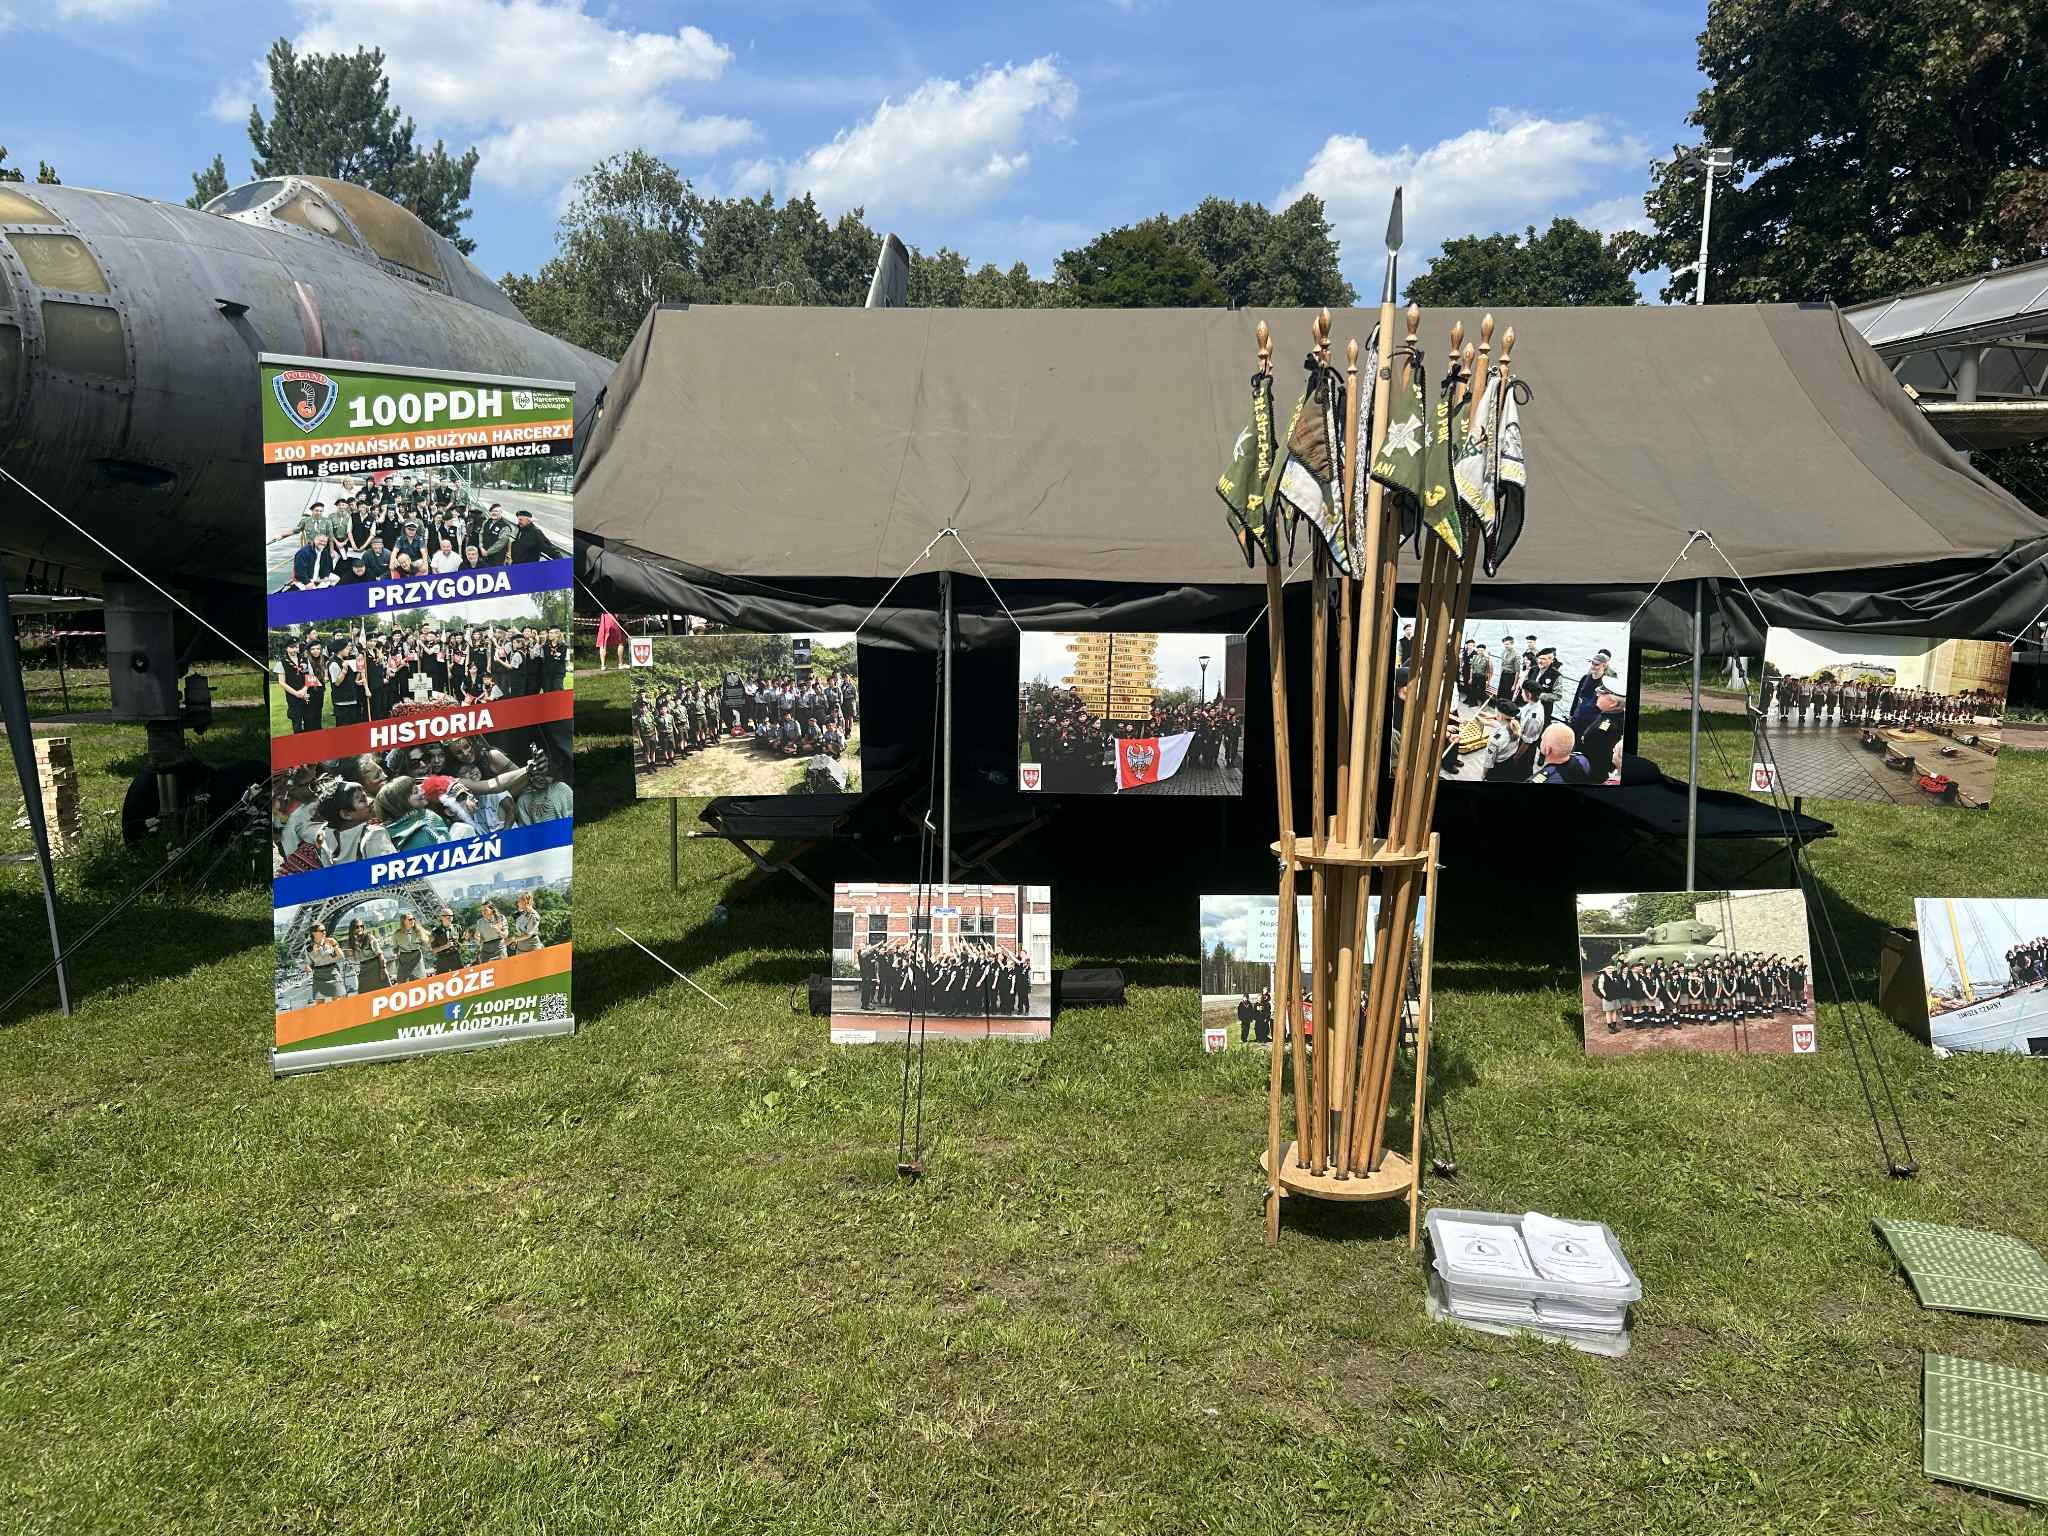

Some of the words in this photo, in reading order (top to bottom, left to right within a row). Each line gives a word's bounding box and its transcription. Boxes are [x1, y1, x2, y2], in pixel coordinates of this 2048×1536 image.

[284, 371, 327, 384] POLAND
[349, 389, 502, 428] 100PDH
[274, 445, 306, 461] 100
[310, 437, 410, 458] POZNAŃSKA
[415, 431, 488, 449] DRUŻYNA
[492, 424, 572, 442] HARCERZY
[286, 463, 314, 477] im.
[318, 456, 394, 476] generała
[397, 448, 488, 467] Stanisława
[491, 442, 551, 458] Maczka
[368, 571, 512, 609] PRZYGODA
[370, 709, 494, 748] HISTORIA
[371, 837, 501, 885] PRZYJAŹŃ
[372, 968, 496, 1016] PODRÓŻE
[397, 1011, 538, 1039] WWW.100PDH.PL
